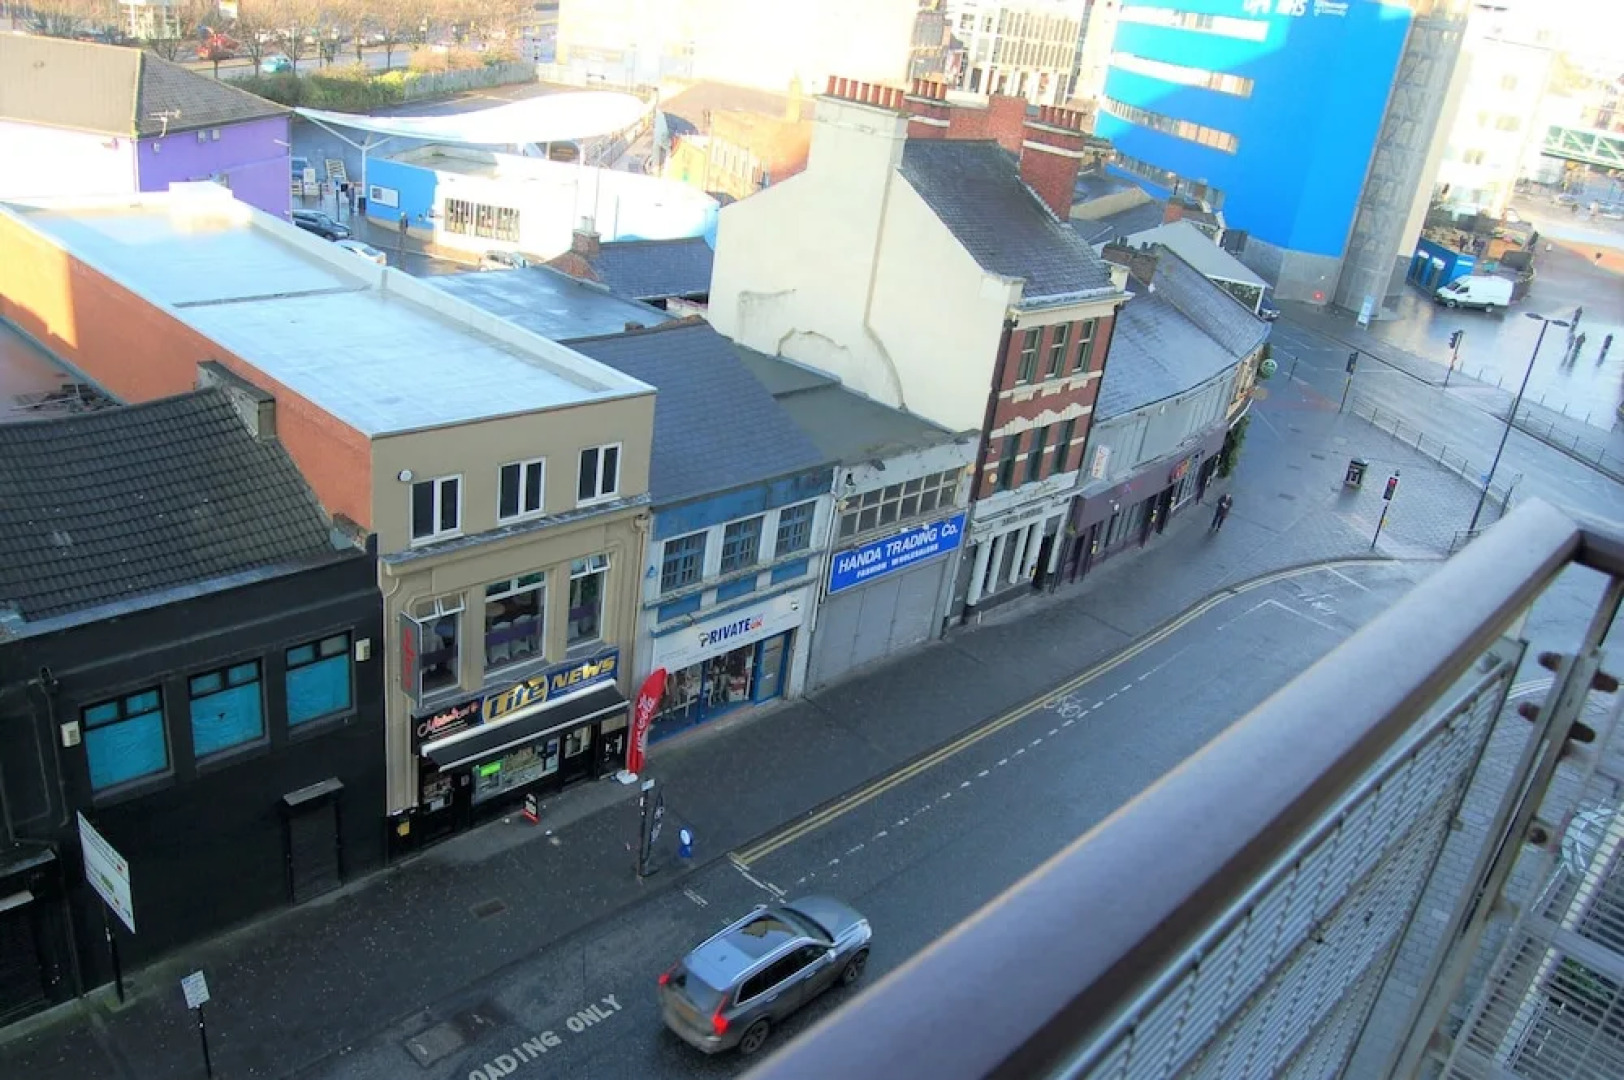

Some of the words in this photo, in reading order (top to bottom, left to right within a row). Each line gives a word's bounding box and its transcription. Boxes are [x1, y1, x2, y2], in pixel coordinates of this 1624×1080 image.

[838, 547, 882, 574] HANDA
[886, 528, 938, 557] TRADING
[566, 994, 623, 1032] ONLY
